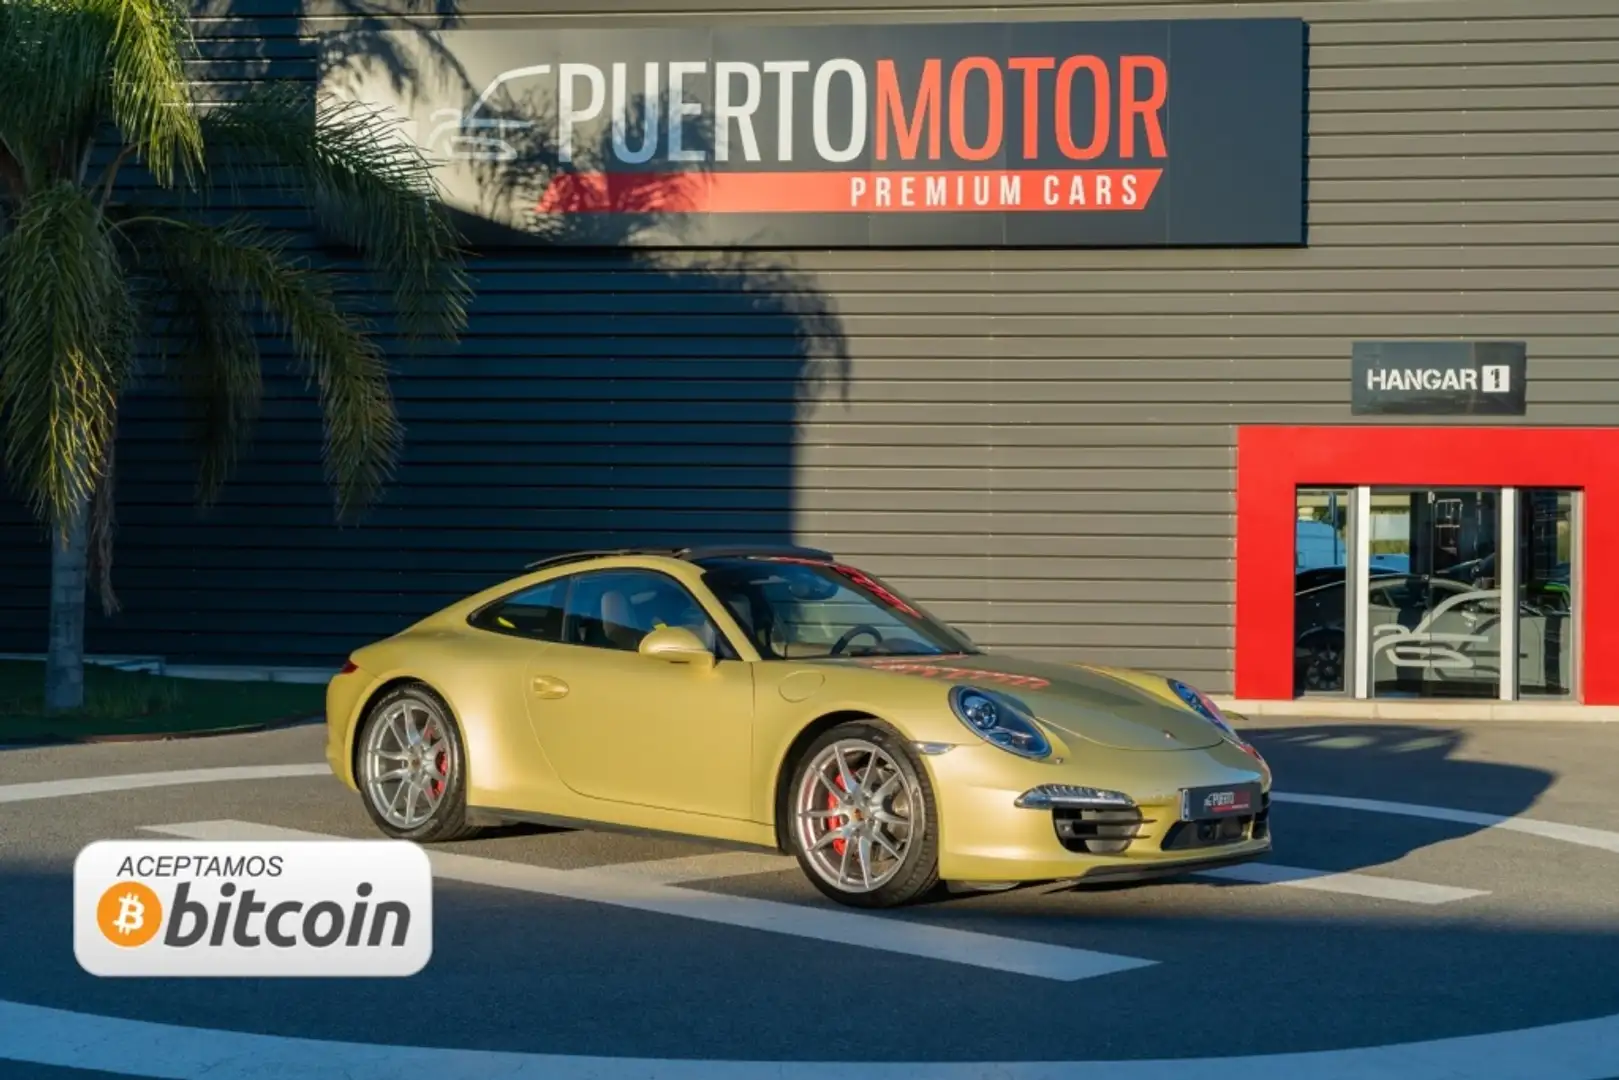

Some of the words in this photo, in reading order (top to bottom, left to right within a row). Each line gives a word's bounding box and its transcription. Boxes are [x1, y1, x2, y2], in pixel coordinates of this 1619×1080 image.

[851, 174, 1021, 207] PREMIUM
[1043, 173, 1137, 206] CARS
[1366, 368, 1478, 390] HANGAR
